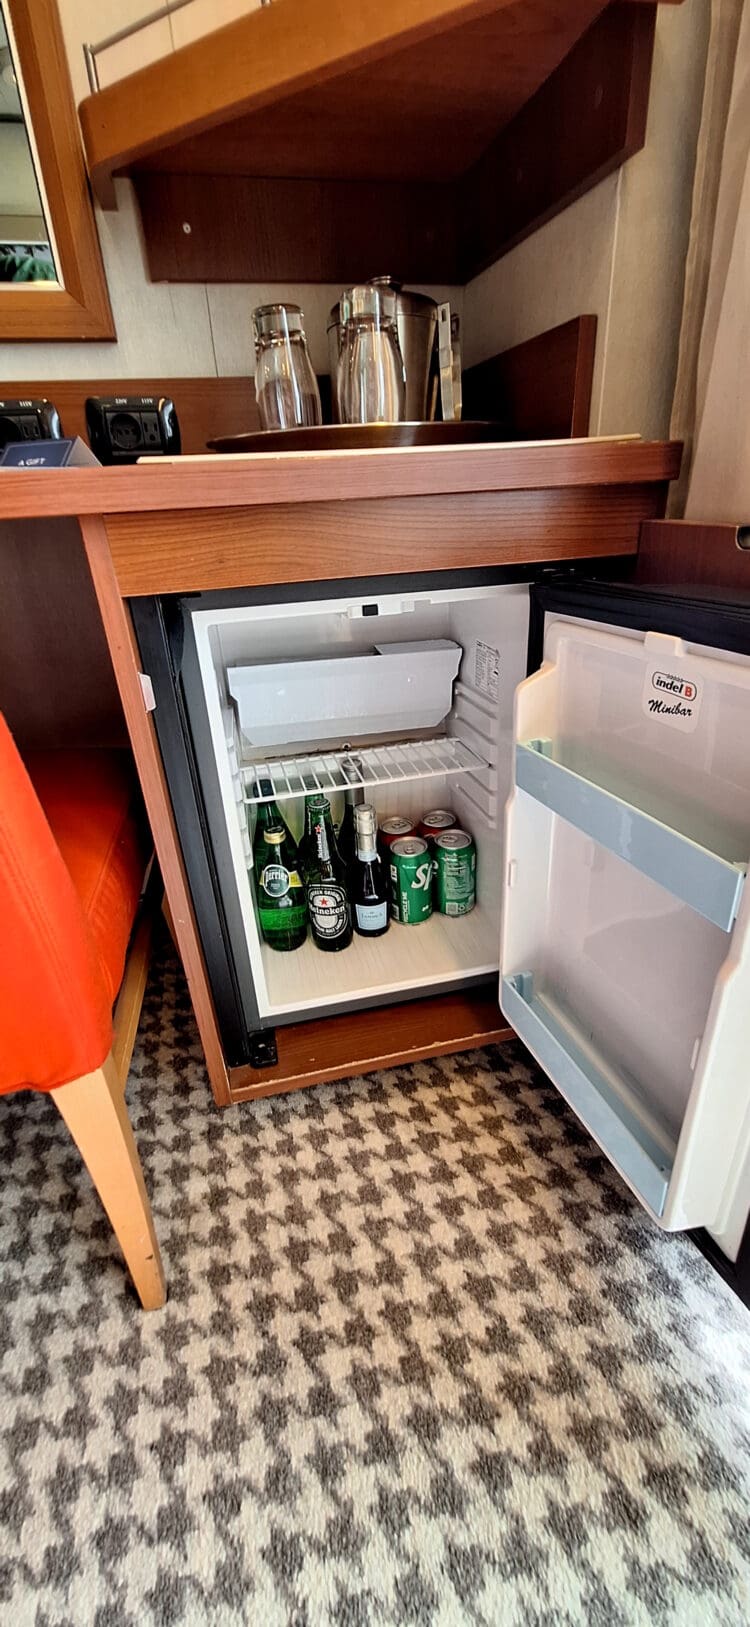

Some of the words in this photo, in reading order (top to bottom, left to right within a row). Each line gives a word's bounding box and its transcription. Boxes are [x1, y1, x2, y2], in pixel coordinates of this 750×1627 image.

[26, 457, 46, 466] GIFT
[655, 676, 684, 694] indel
[684, 686, 693, 698] B
[648, 699, 692, 717] Minibar
[309, 903, 345, 915] Heineken
